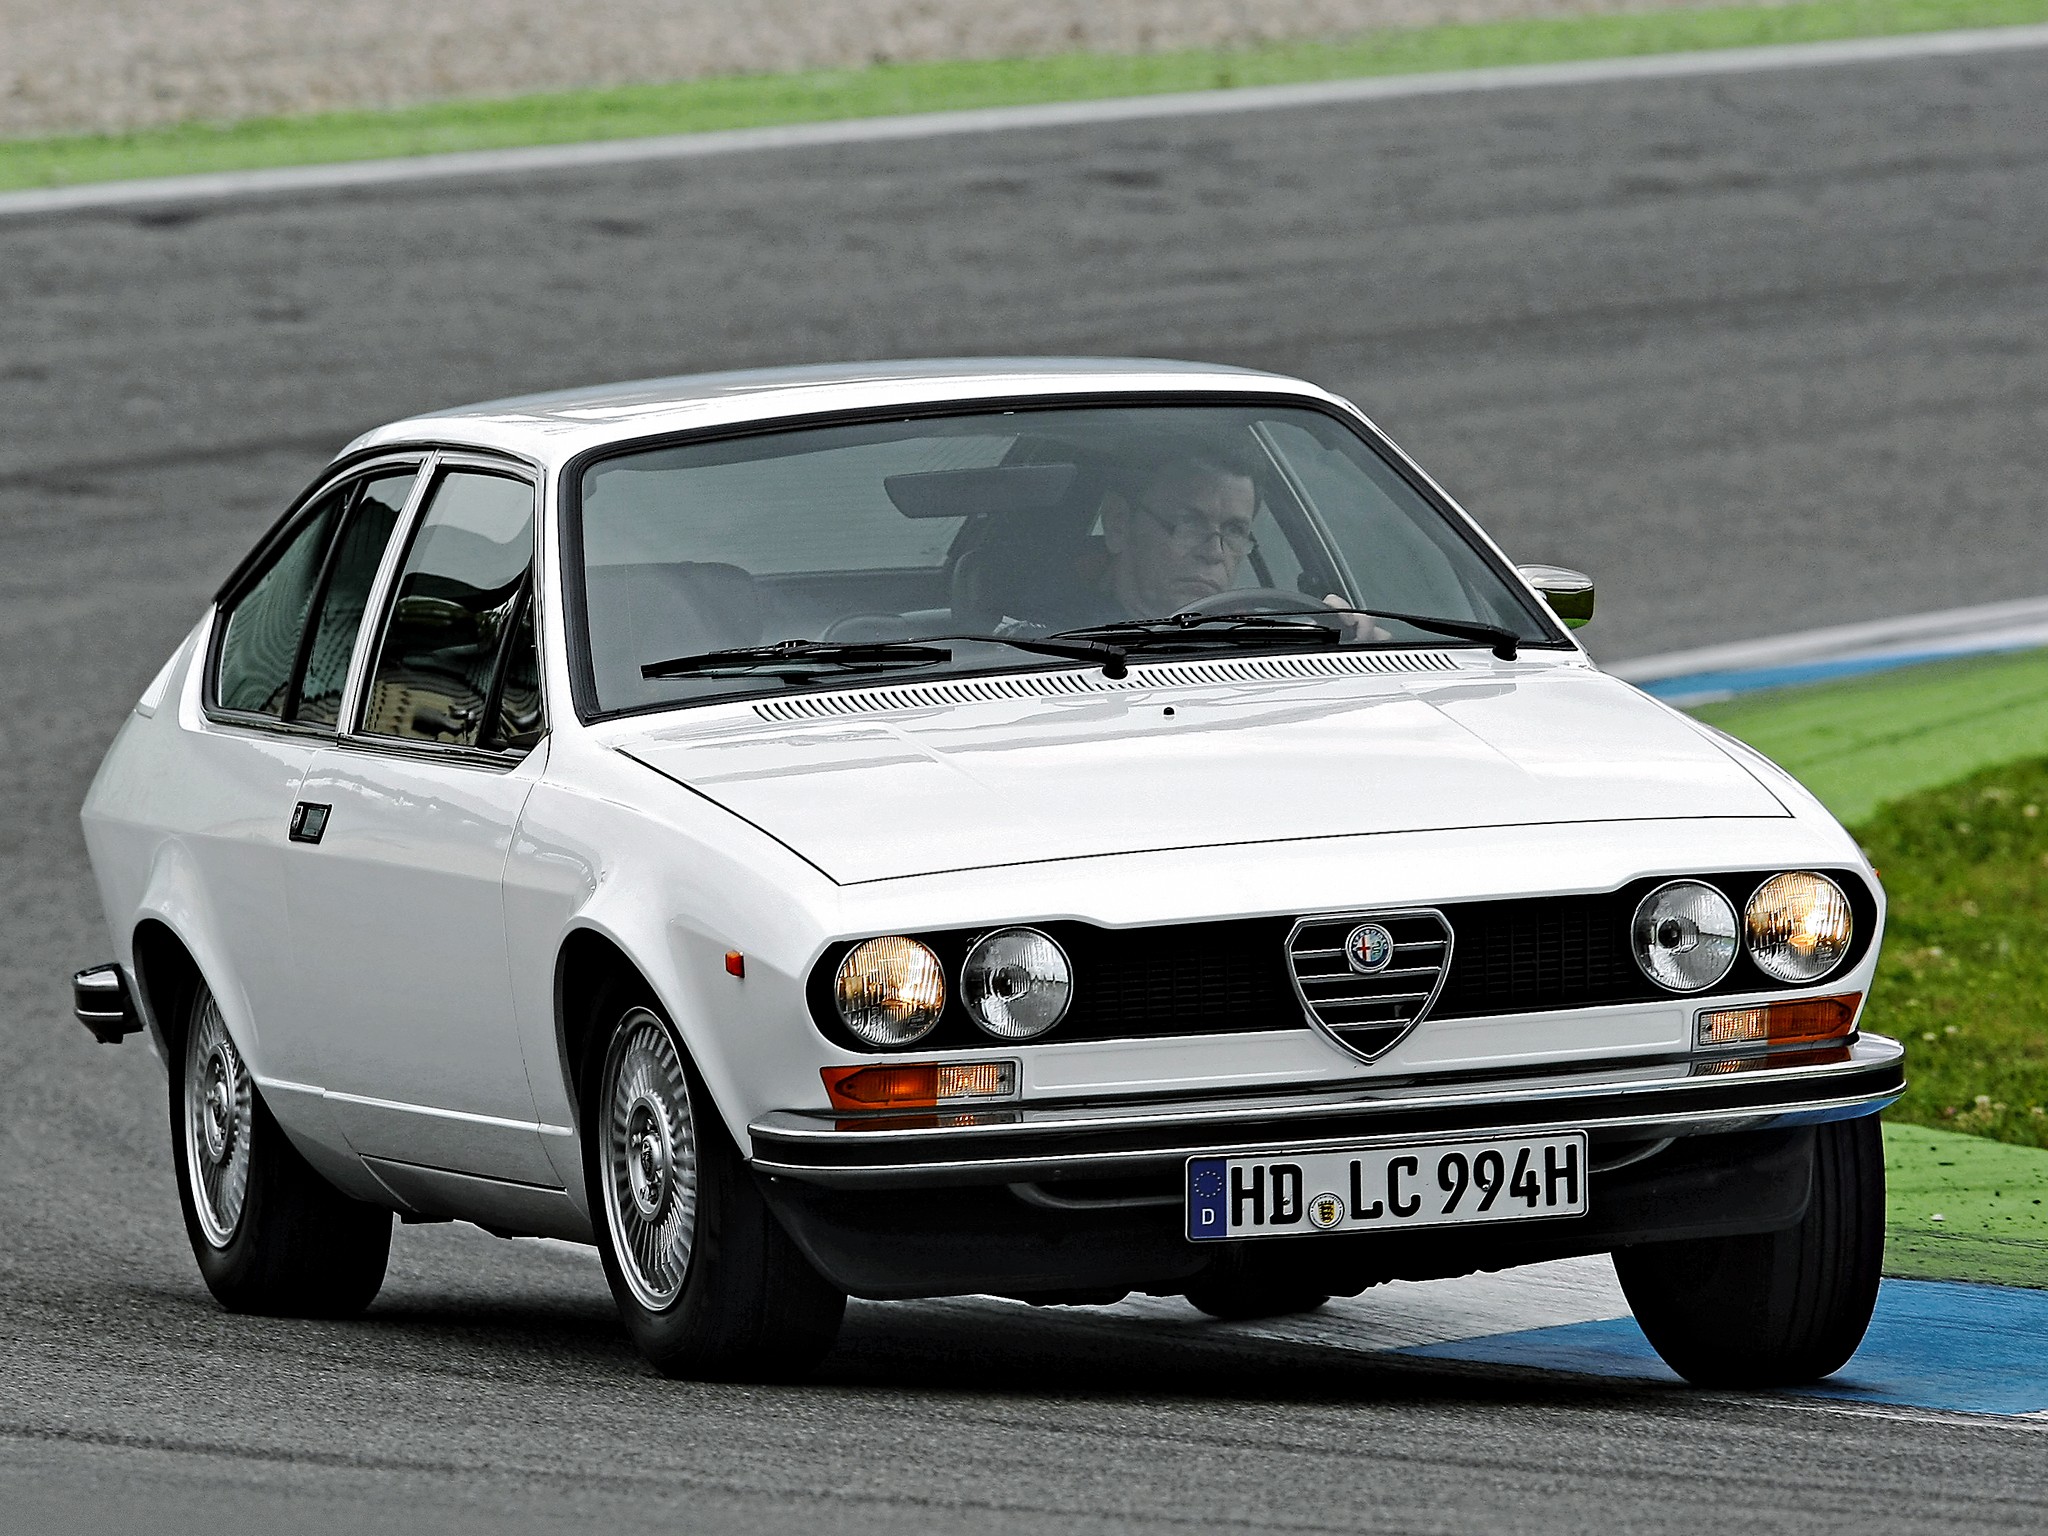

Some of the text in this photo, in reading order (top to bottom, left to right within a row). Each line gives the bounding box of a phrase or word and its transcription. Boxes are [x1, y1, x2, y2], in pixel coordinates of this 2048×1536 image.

[1230, 1163, 1303, 1227] HD
[1350, 1156, 1421, 1220] LC
[1437, 1143, 1579, 1215] 994H
[1201, 1207, 1215, 1225] D
